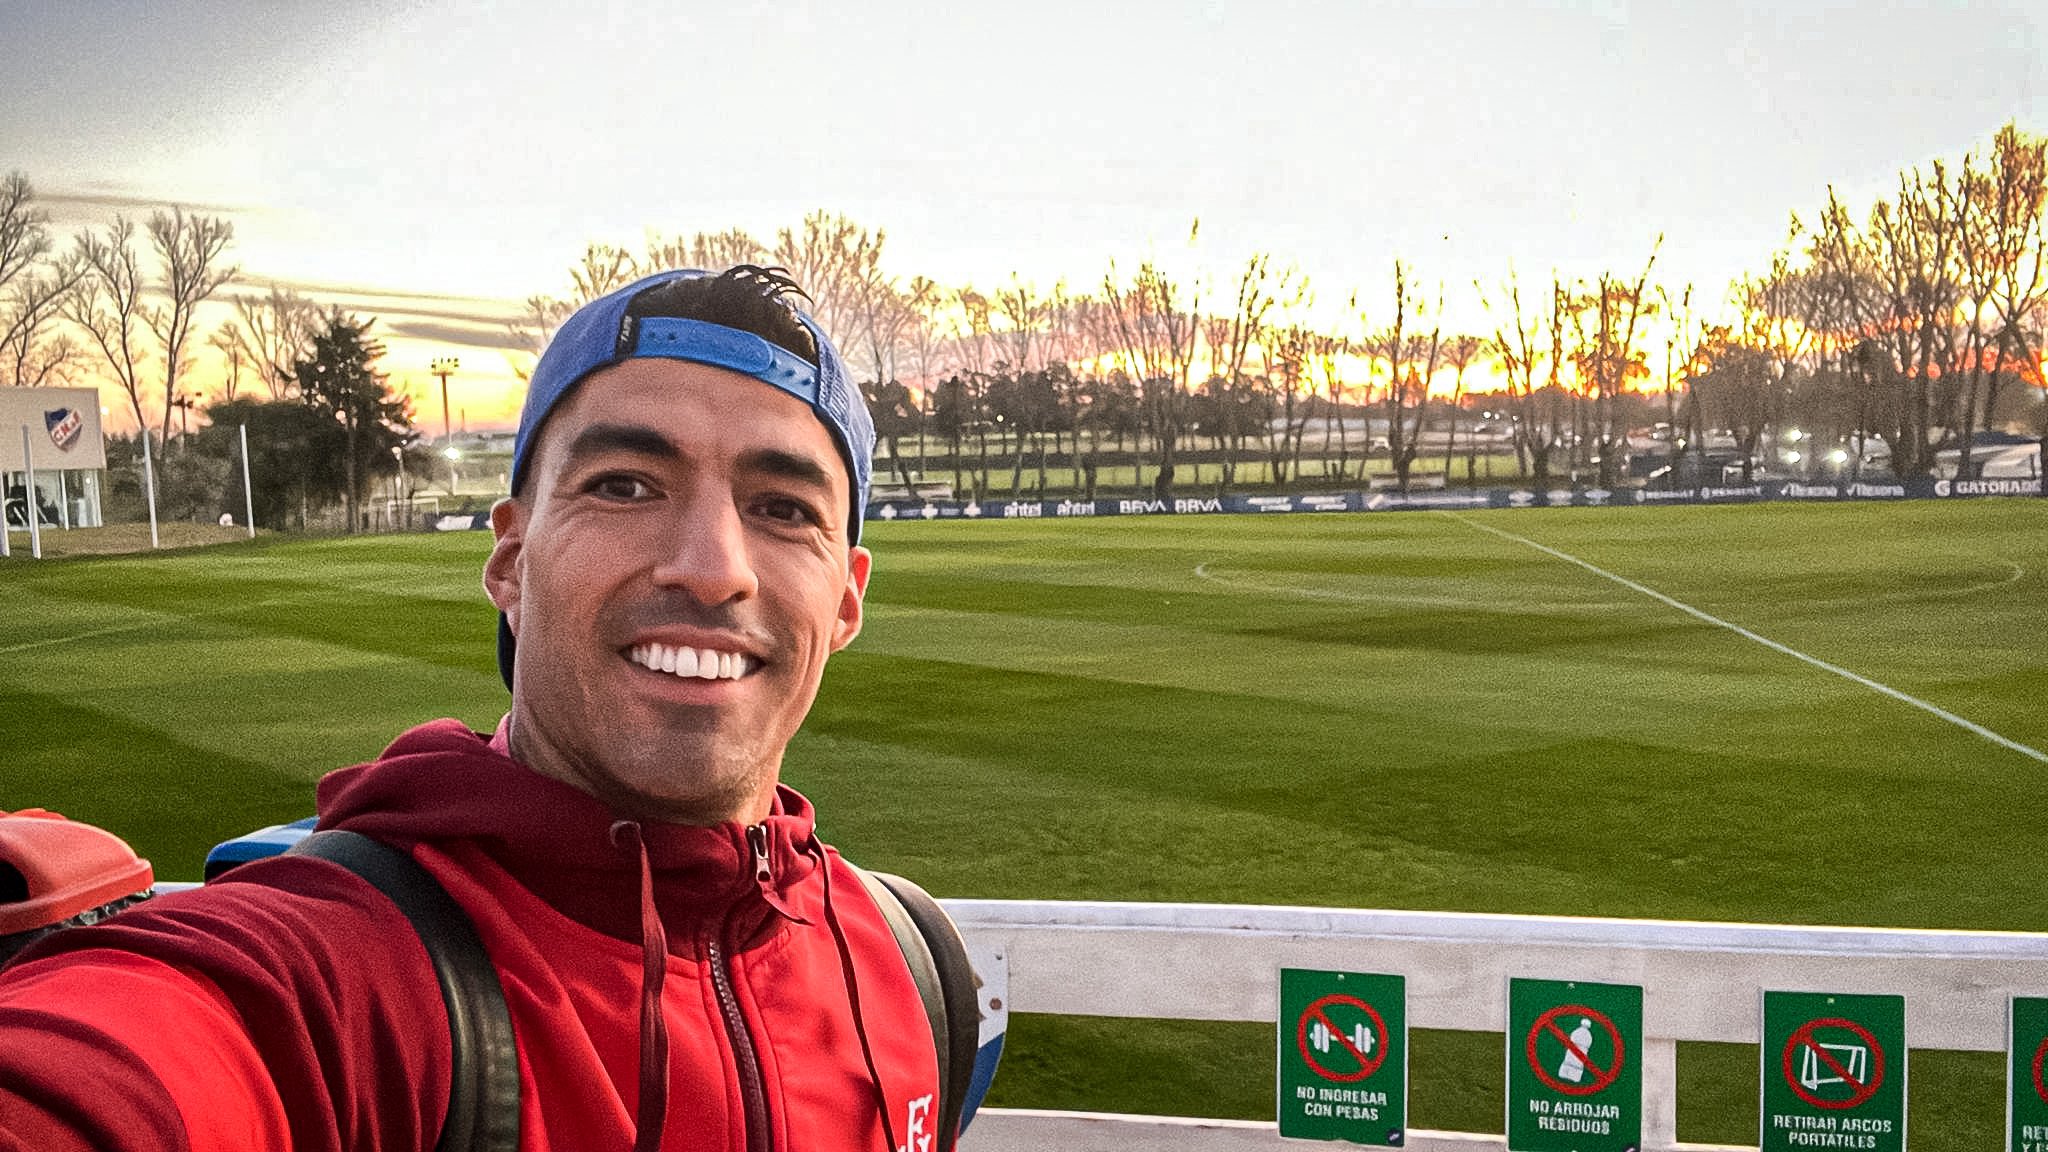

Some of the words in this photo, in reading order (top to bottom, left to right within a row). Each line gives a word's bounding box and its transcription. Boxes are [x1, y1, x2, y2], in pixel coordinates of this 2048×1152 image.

[1956, 479, 2042, 494] GATORADE
[1119, 499, 1166, 514] BBVA
[1174, 498, 1223, 513] BBVA
[1296, 1086, 1316, 1100] NO
[1319, 1088, 1388, 1106] INGRESAR
[1304, 1102, 1332, 1117] CON
[1336, 1105, 1379, 1121] PESAS
[1529, 1099, 1549, 1114] NO
[1554, 1101, 1620, 1119] ARROJAR
[1538, 1116, 1610, 1136] RESIDUOS
[1773, 1114, 1837, 1131] RETIRAR
[1842, 1117, 1893, 1133] ARCOS
[1788, 1131, 1876, 1149] PORTATILES
